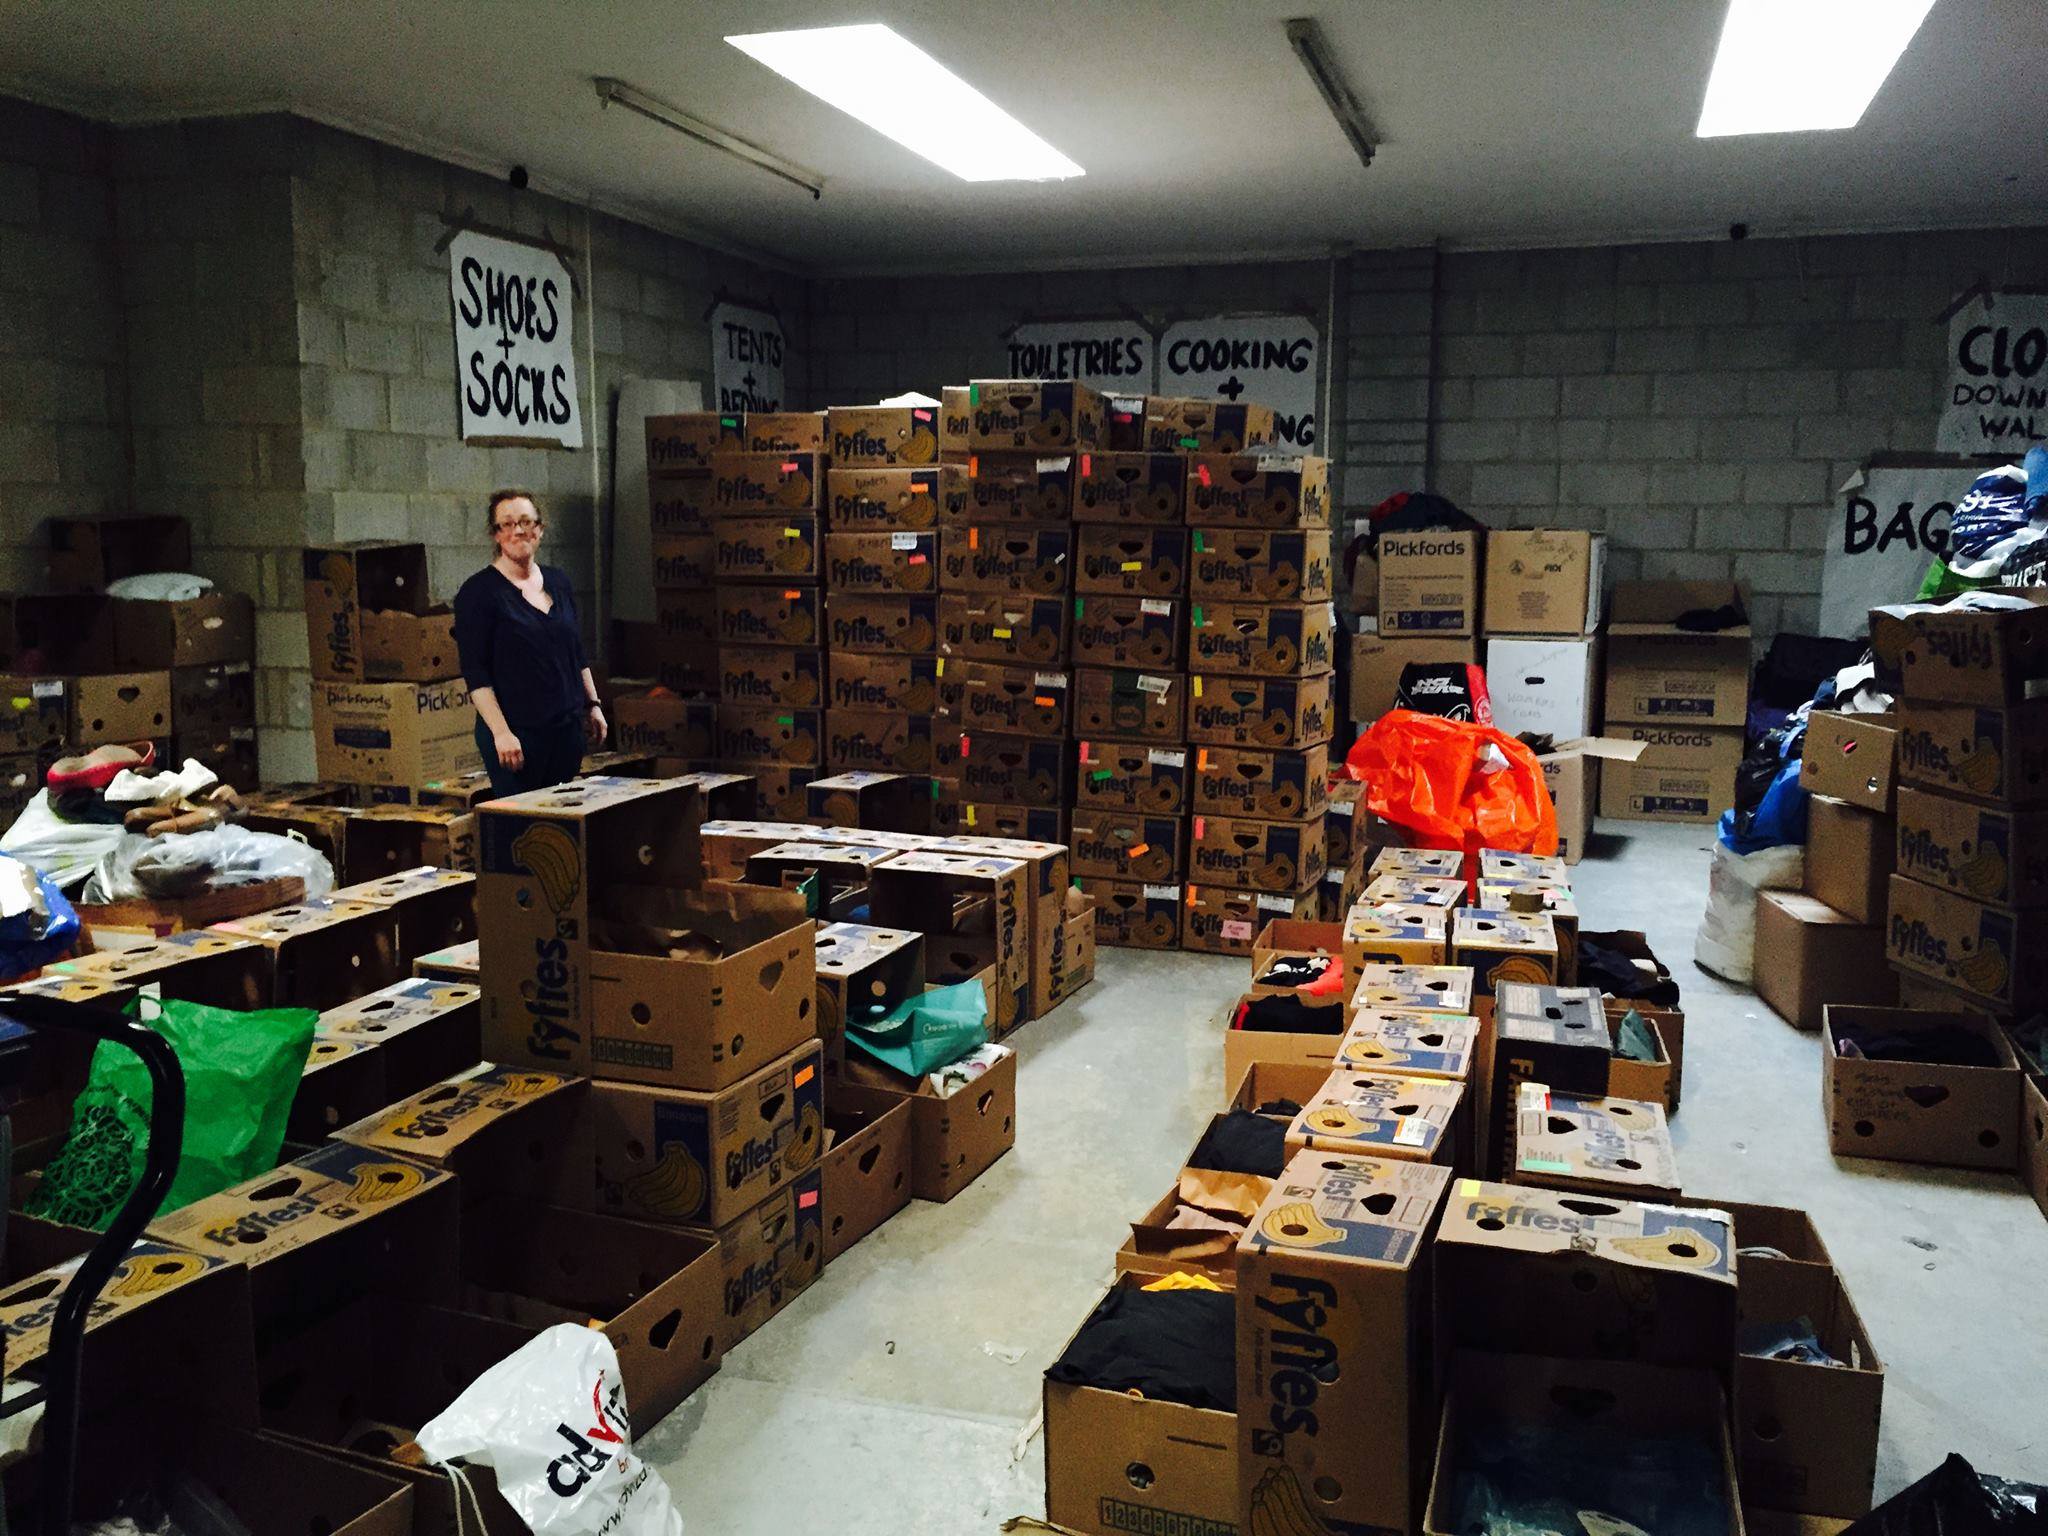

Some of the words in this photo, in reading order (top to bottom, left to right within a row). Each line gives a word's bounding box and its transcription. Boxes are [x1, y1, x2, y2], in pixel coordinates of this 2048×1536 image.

[459, 257, 559, 343] SHOES
[722, 322, 783, 368] TENTS
[1007, 337, 1143, 380] TOILETRIES
[1167, 337, 1313, 375] COOKING
[466, 350, 571, 426] SOCKS
[1953, 383, 2047, 410] DOWN
[834, 432, 887, 464] fyffes
[834, 496, 887, 528] fyffes
[1384, 540, 1465, 557] Pickfords
[831, 559, 884, 590] fyffes
[834, 617, 886, 648] fyffes
[1633, 729, 1713, 748] Pickfords
[525, 938, 582, 1060] fyffes
[204, 1201, 316, 1246] fyffes
[1466, 1202, 1580, 1233] fyffes
[1255, 1273, 1337, 1437] fyffes
